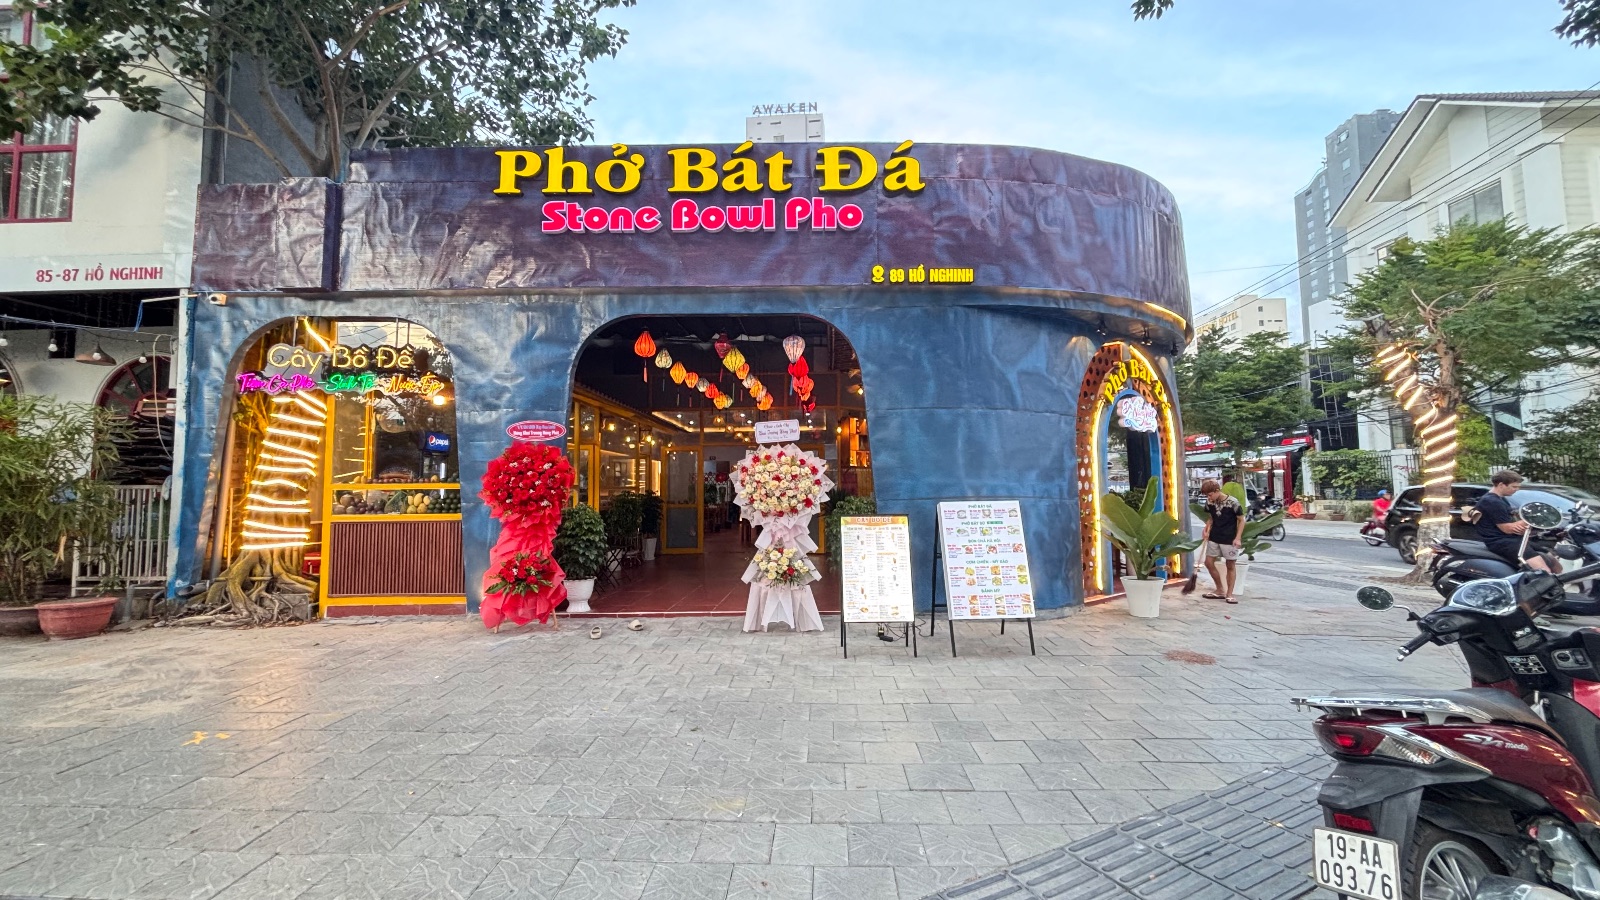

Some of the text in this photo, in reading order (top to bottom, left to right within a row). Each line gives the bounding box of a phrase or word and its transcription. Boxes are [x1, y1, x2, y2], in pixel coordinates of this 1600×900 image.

[752, 101, 818, 115] AWAKEN
[493, 140, 927, 196] Phở Bát Đá
[541, 196, 864, 233] Stone Bowl Pho
[36, 262, 164, 283] 85-87 HỒ NGHINH
[889, 268, 905, 283] 89
[929, 268, 974, 283] NGHINH
[268, 345, 414, 374] Cây Bồ Đề
[325, 374, 357, 391] Sinh
[435, 438, 449, 447] pepsi
[1327, 833, 1382, 869] 19-AA
[1320, 859, 1393, 900] 093.76
